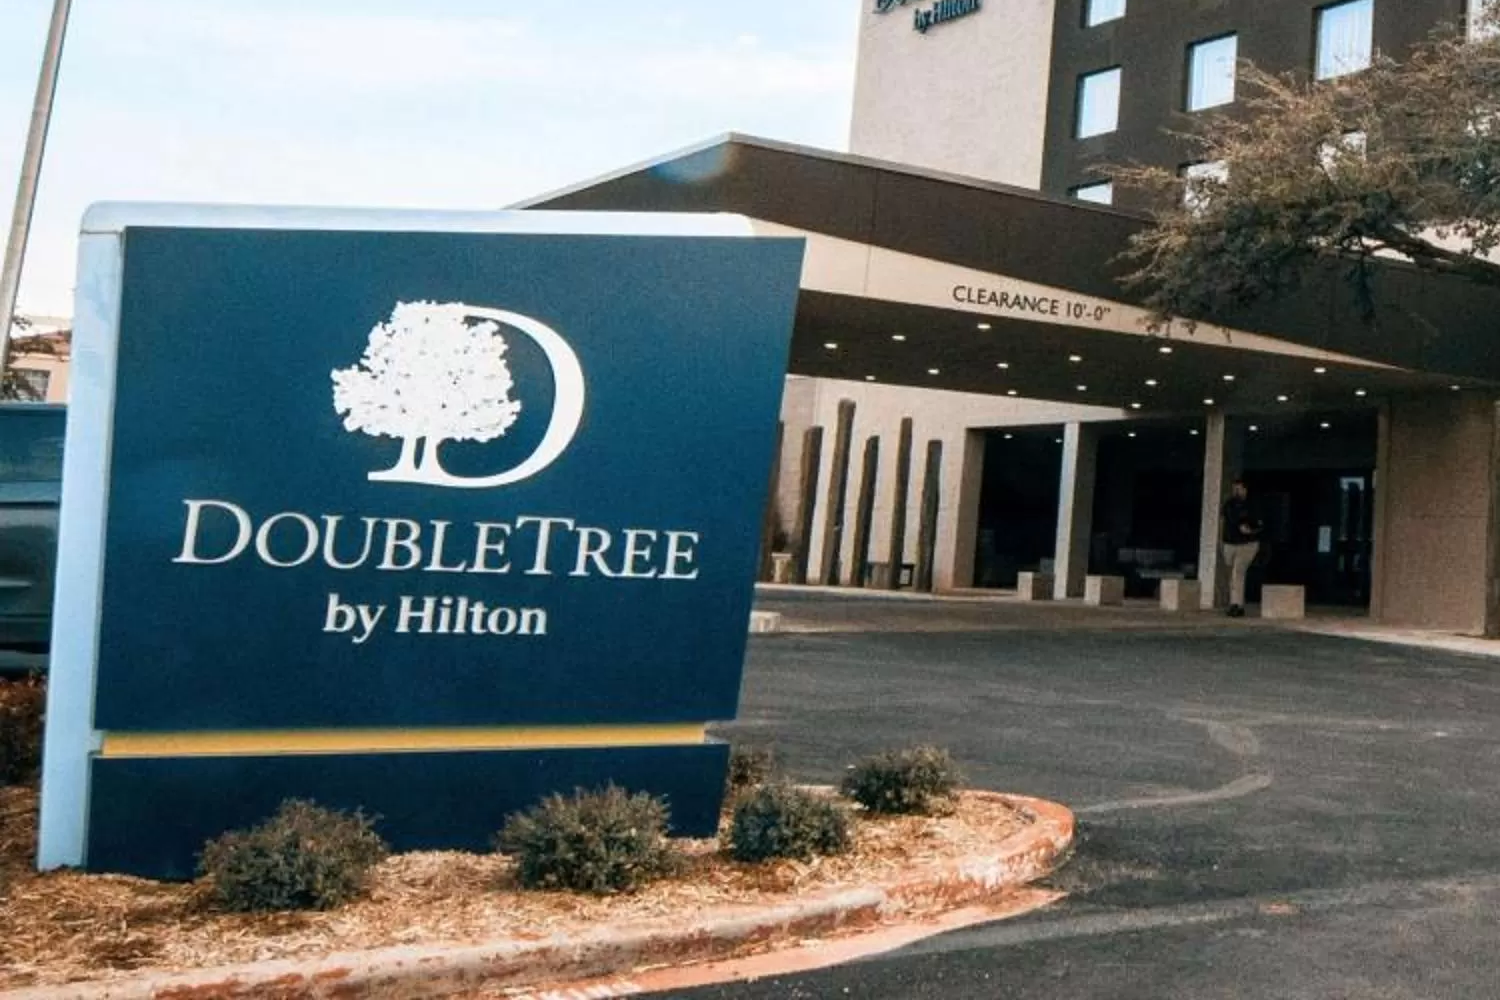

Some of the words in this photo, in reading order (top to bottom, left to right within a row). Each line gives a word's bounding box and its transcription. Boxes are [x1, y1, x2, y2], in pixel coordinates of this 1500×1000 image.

[953, 285, 1059, 316] CLEARANCE
[171, 499, 700, 580] DOUBLETREE
[323, 592, 387, 643] by
[394, 596, 548, 636] Hilton
